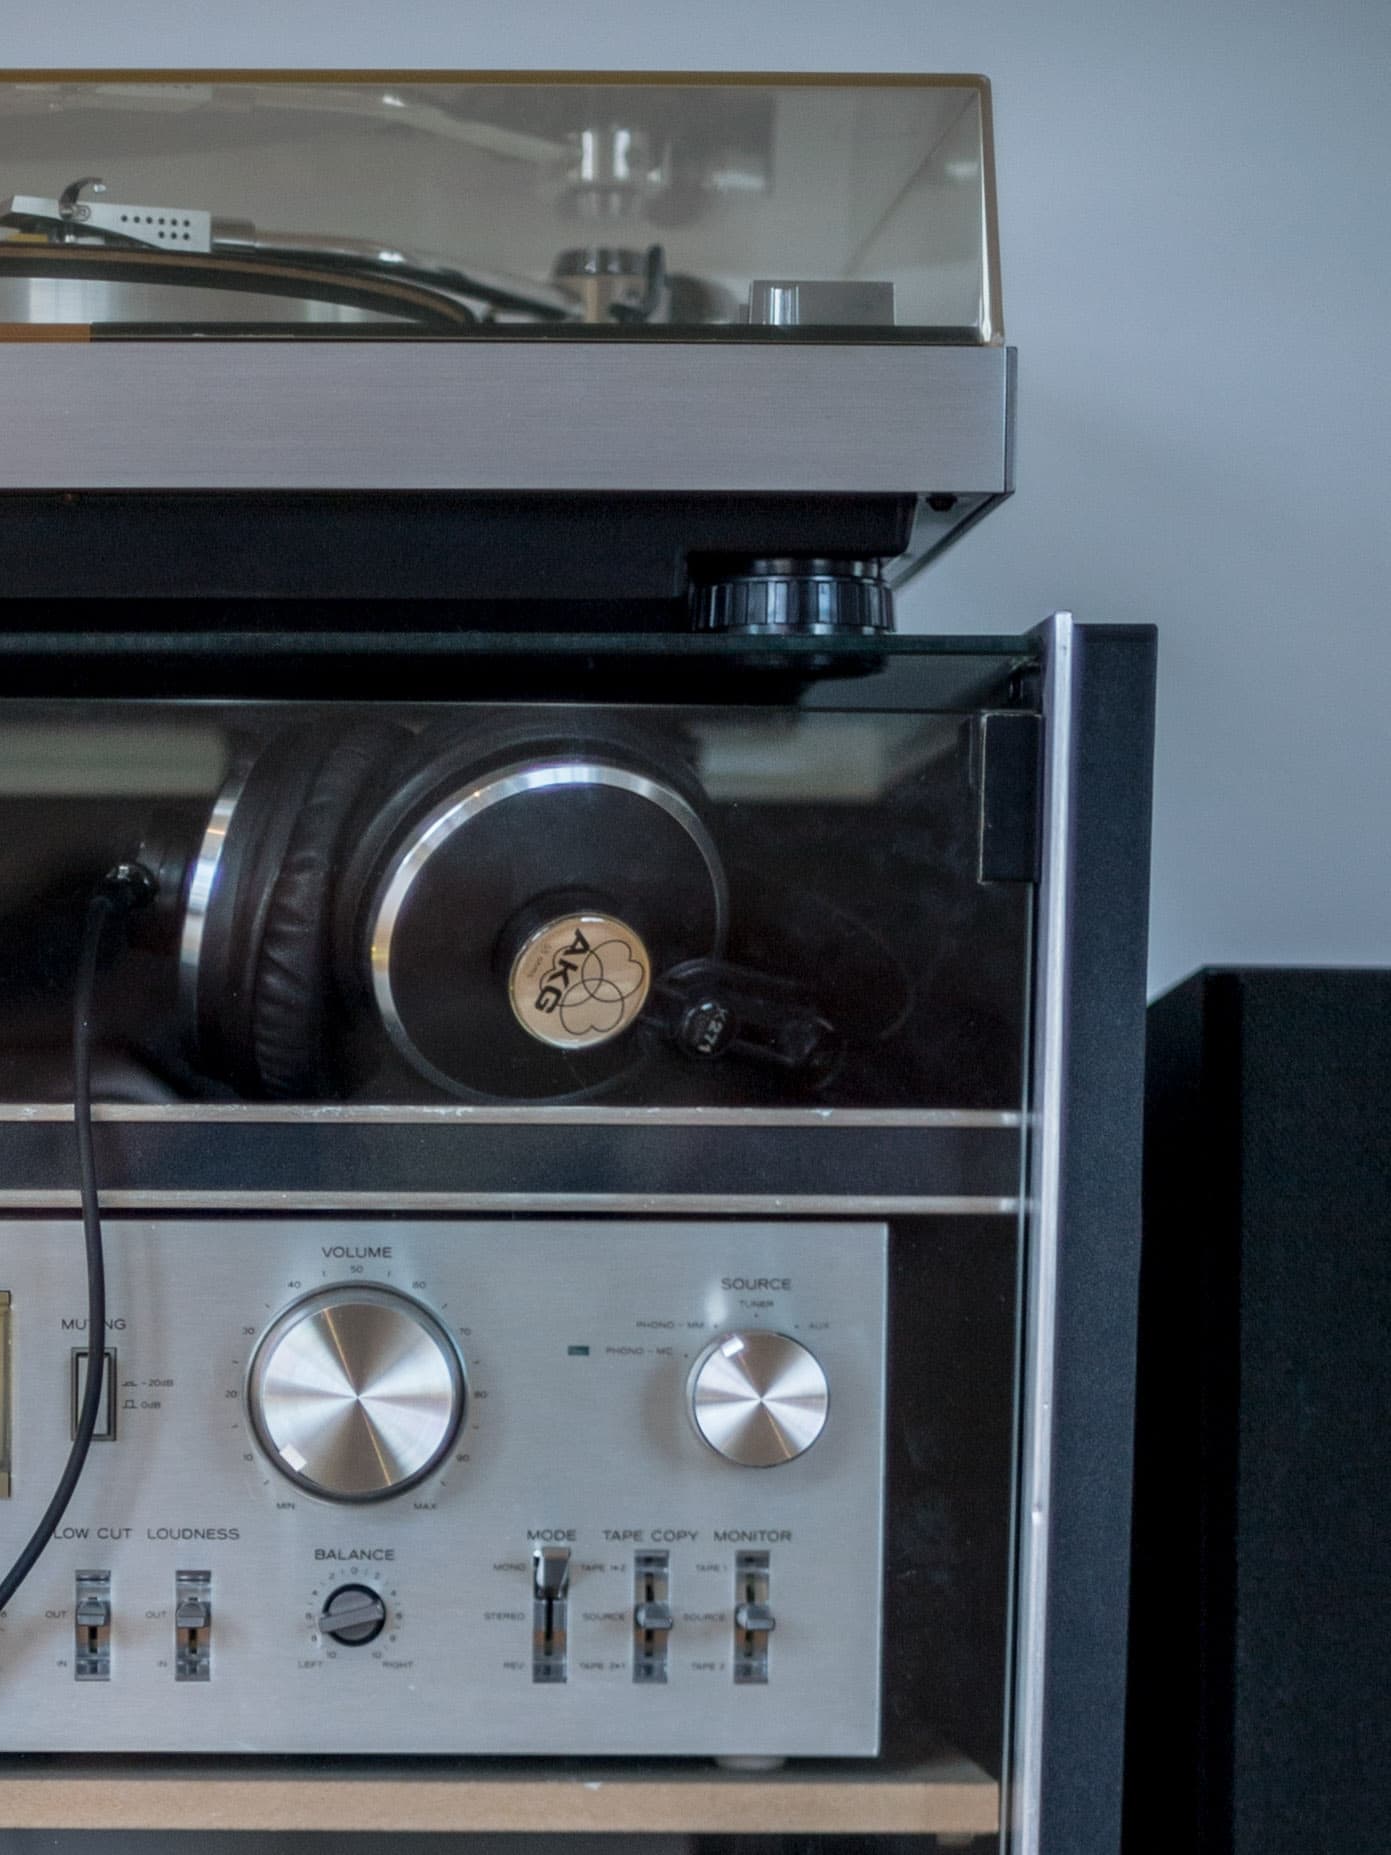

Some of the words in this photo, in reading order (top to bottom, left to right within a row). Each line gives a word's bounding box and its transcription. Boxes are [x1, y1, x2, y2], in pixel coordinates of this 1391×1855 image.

[535, 928, 590, 1014] AKG
[322, 1247, 392, 1258] VOLUME
[351, 1265, 363, 1273] 50
[288, 1281, 301, 1289] 40
[721, 1278, 792, 1291] SOURCE
[61, 1318, 127, 1330] MUNG
[636, 1321, 674, 1329] PHONO
[459, 1328, 471, 1336] 70
[225, 1390, 238, 1398] 20
[54, 1528, 90, 1540] LOW
[97, 1528, 132, 1540] CUT
[148, 1528, 240, 1540] LOUDNESS
[527, 1530, 577, 1541] MODE
[603, 1530, 643, 1541] TAPE
[651, 1530, 699, 1542] COPY
[713, 1530, 793, 1542] MONITOR
[315, 1549, 395, 1560] BALANCE
[696, 1564, 720, 1572] TAPE
[45, 1610, 67, 1618] OUT
[146, 1610, 167, 1619] OUT
